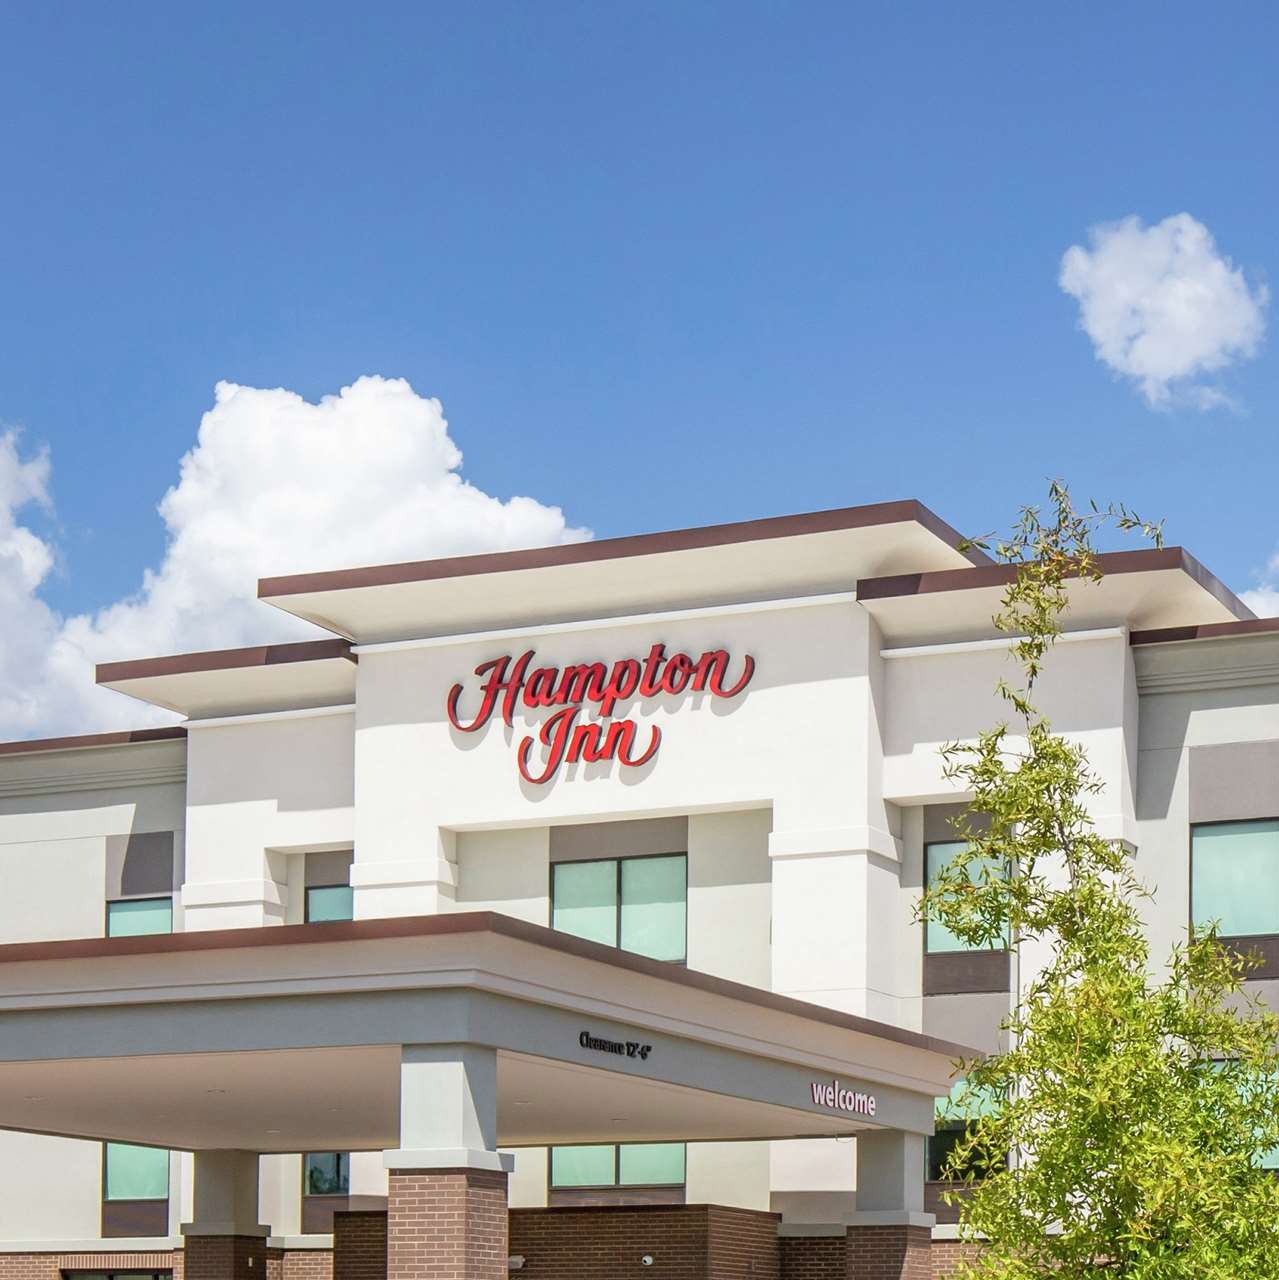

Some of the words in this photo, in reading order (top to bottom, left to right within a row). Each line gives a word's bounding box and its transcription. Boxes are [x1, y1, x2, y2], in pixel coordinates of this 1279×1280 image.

[447, 643, 755, 732] Hampton
[518, 707, 662, 784] Inn
[579, 1031, 625, 1056] Clearance
[810, 1080, 876, 1116] welcome
